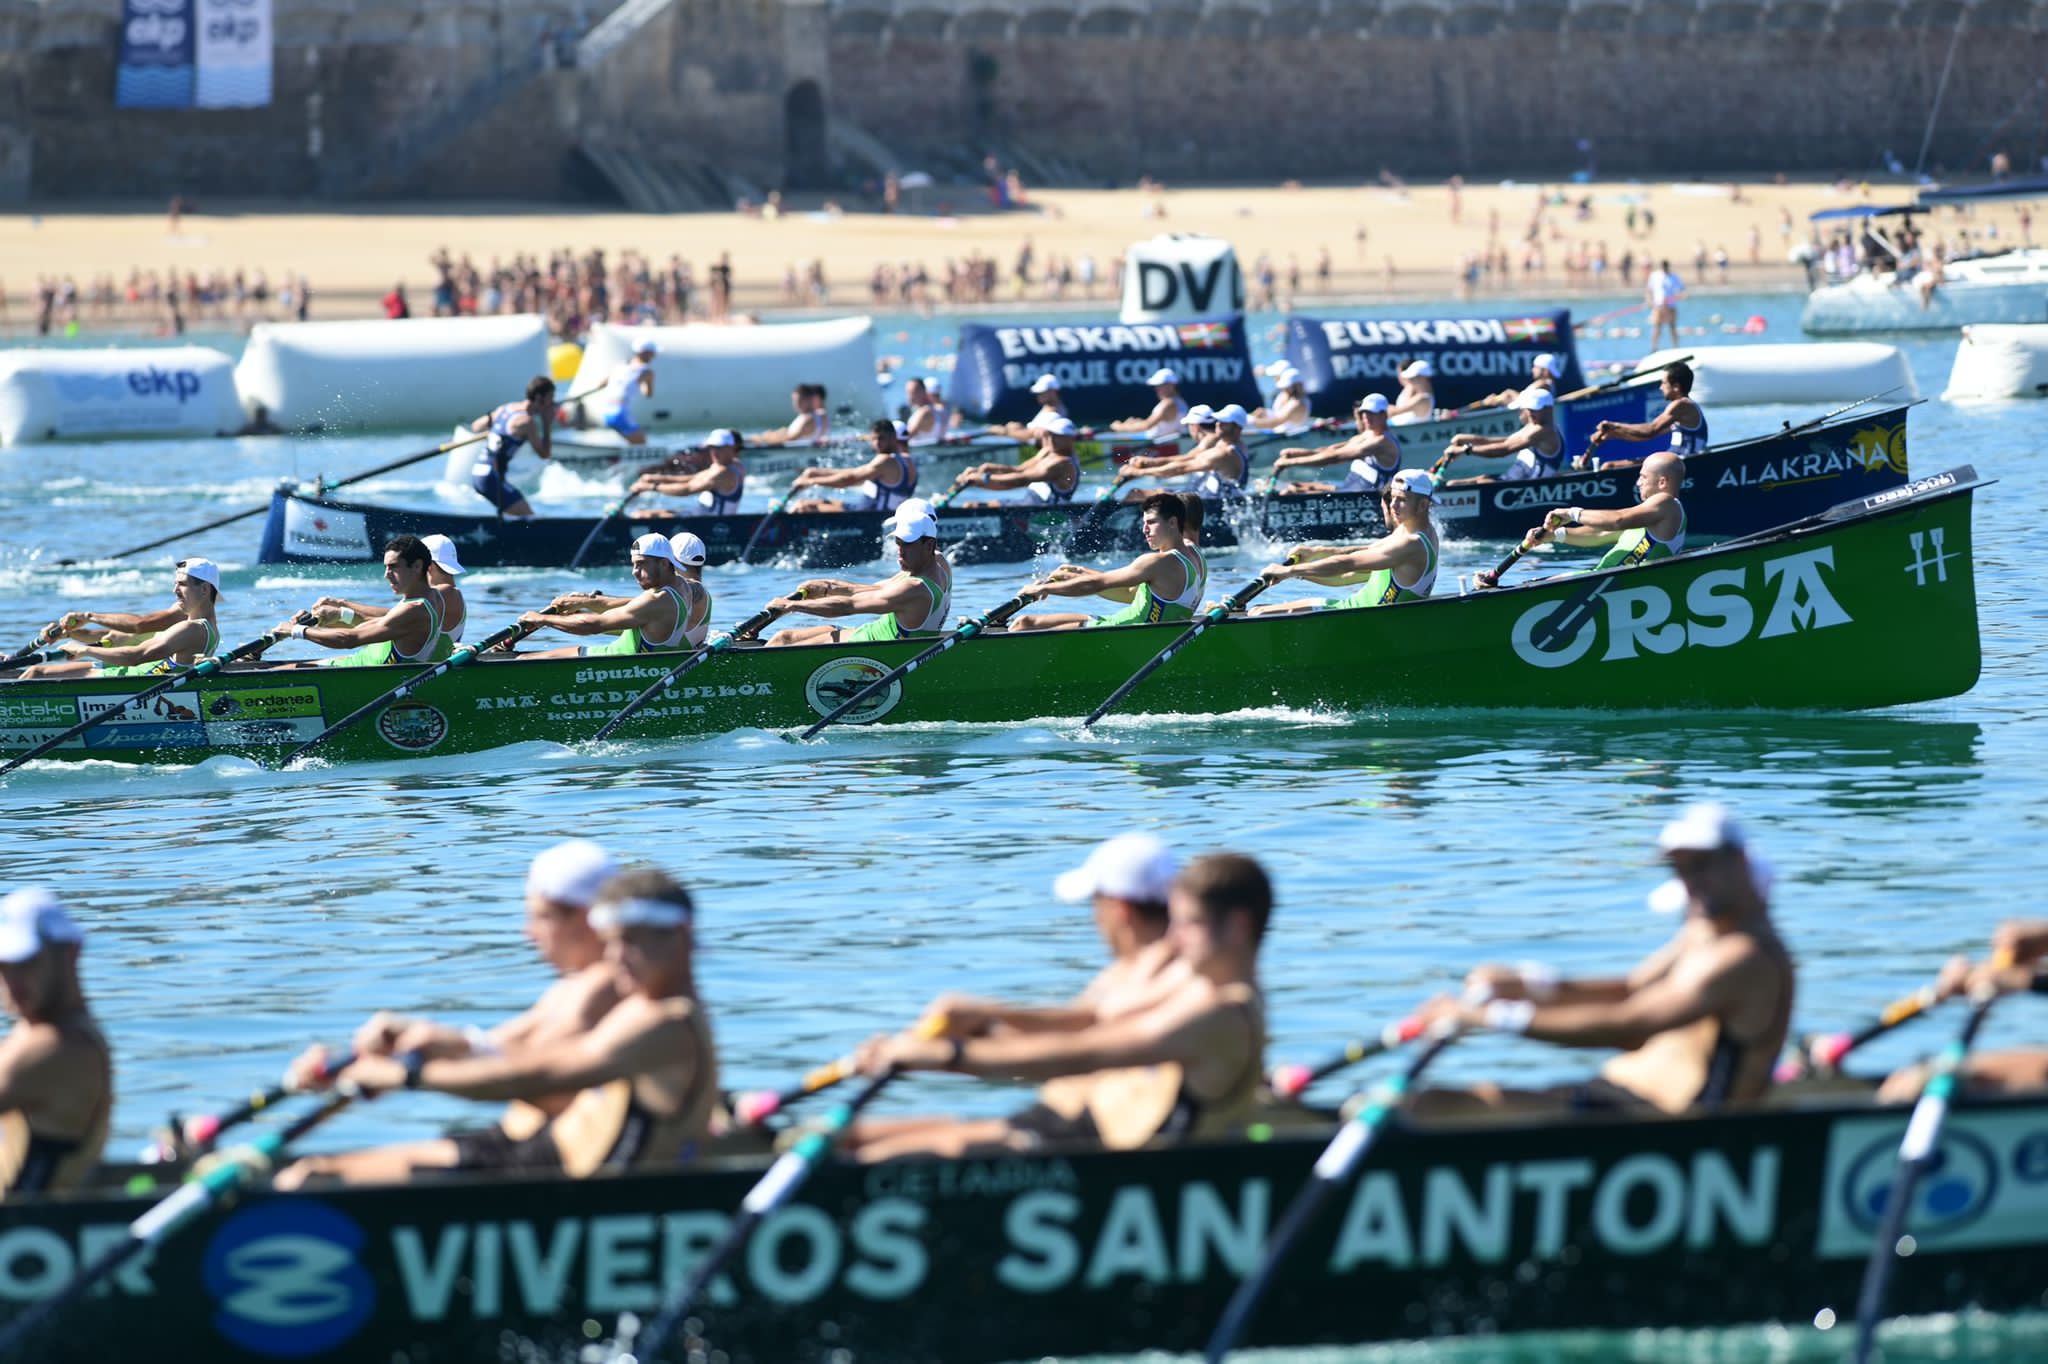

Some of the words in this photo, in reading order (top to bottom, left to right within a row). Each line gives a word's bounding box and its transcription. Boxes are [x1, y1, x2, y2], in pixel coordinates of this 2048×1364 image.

[1138, 258, 1223, 315] DV
[995, 324, 1181, 358] EUSKADI
[1321, 319, 1507, 350] EUSKADI
[1331, 353, 1434, 379] BASQE
[1439, 350, 1568, 377] COUNTY
[127, 364, 201, 404] ekp
[1716, 441, 1890, 488] ALAKRANA
[1494, 478, 1617, 510] CAMPOS
[1267, 509, 1378, 528] BERMEO
[1511, 545, 1854, 669] ORSA
[575, 665, 672, 684] gipuzkoa
[244, 694, 315, 707] endanea
[476, 695, 538, 710] AMA
[547, 705, 705, 721] HONDARIBIA
[392, 1199, 930, 1320] VIVEROS
[997, 1180, 1271, 1292] SAN
[1332, 1147, 1781, 1272] ANTON
